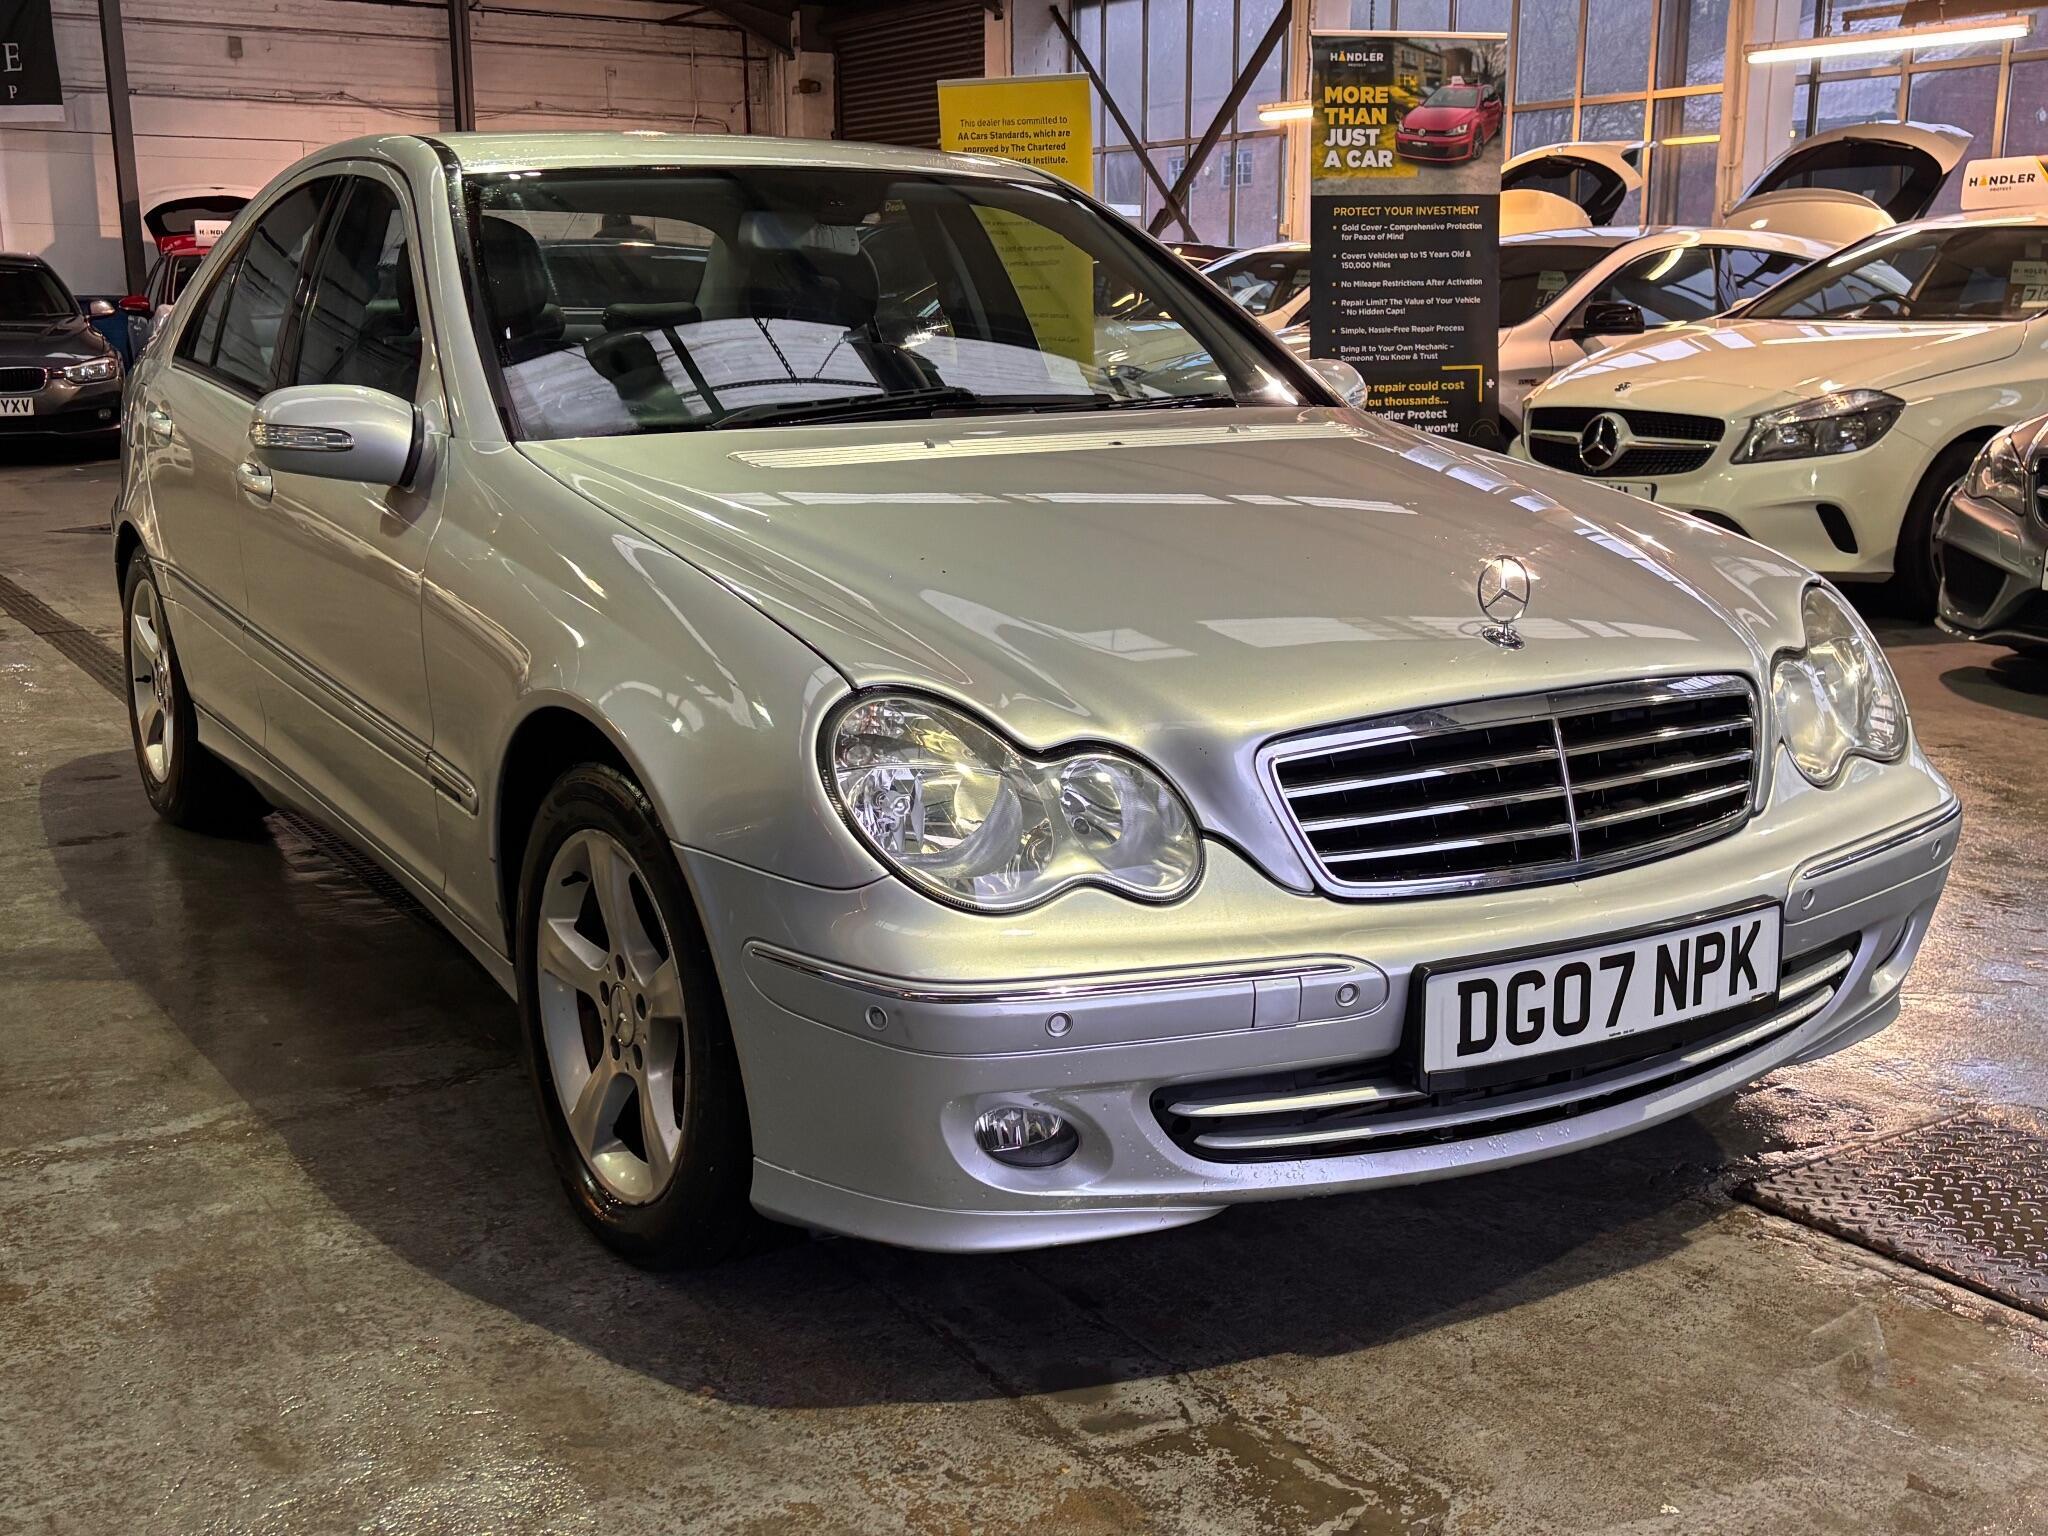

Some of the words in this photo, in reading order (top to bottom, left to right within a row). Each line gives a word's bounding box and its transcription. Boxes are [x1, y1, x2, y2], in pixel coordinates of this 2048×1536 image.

[1324, 86, 1389, 104] MORE
[1324, 107, 1387, 125] THAN
[960, 119, 975, 128] This
[977, 119, 1000, 127] dealer
[1002, 118, 1015, 126] has
[1017, 116, 1058, 126] committed
[1059, 116, 1068, 124] to
[957, 132, 969, 141] AA
[970, 132, 988, 140] Cars
[990, 130, 1032, 140] Standards,
[1033, 129, 1056, 138] which
[1324, 128, 1380, 147] JUST
[963, 145, 999, 153] approved
[1000, 144, 1009, 154] by
[1011, 143, 1025, 152] The
[1027, 142, 1066, 151] Chartered
[1033, 156, 1068, 164] Institute.
[1323, 150, 1342, 168] A
[1346, 150, 1393, 168] CAR
[1333, 207, 1382, 216] PROTECT
[1384, 206, 1414, 216] YOUR
[1416, 205, 1480, 215] INVESTMENT
[1389, 223, 1445, 232] Comprehensive
[1446, 222, 1483, 230] Protection
[1341, 233, 1352, 241] for
[1386, 232, 1404, 240] Mind
[1341, 252, 1366, 260] Covers
[1420, 251, 1427, 259] 15
[1451, 250, 1464, 258] Old
[1466, 250, 1471, 258] &
[1353, 280, 1381, 288] Mileage
[1382, 279, 1425, 287] Restrictions
[1446, 277, 1483, 286] Activation
[1341, 299, 1364, 307] Repair
[1366, 298, 1388, 306] Limit?
[1389, 298, 1403, 306] The
[1404, 297, 1425, 305] Value
[1425, 297, 1434, 305] of
[1454, 296, 1481, 304] Vehicle
[1385, 307, 1406, 315] Caps!
[1340, 327, 1367, 335] Simple,
[1411, 325, 1435, 333] Repair
[1436, 324, 1465, 332] Process
[1340, 345, 1360, 353] Bring
[1414, 343, 1448, 351] Mechanic
[1374, 382, 1407, 393] repair
[1408, 381, 1439, 391] could
[1441, 381, 1465, 390] cost
[1368, 398, 1381, 406] ou
[1384, 395, 1449, 406] thousands...
[1407, 409, 1447, 419] Protect
[1424, 422, 1459, 433] won't!
[1457, 951, 1635, 1057] DG07
[1654, 920, 1762, 1017] NPK
